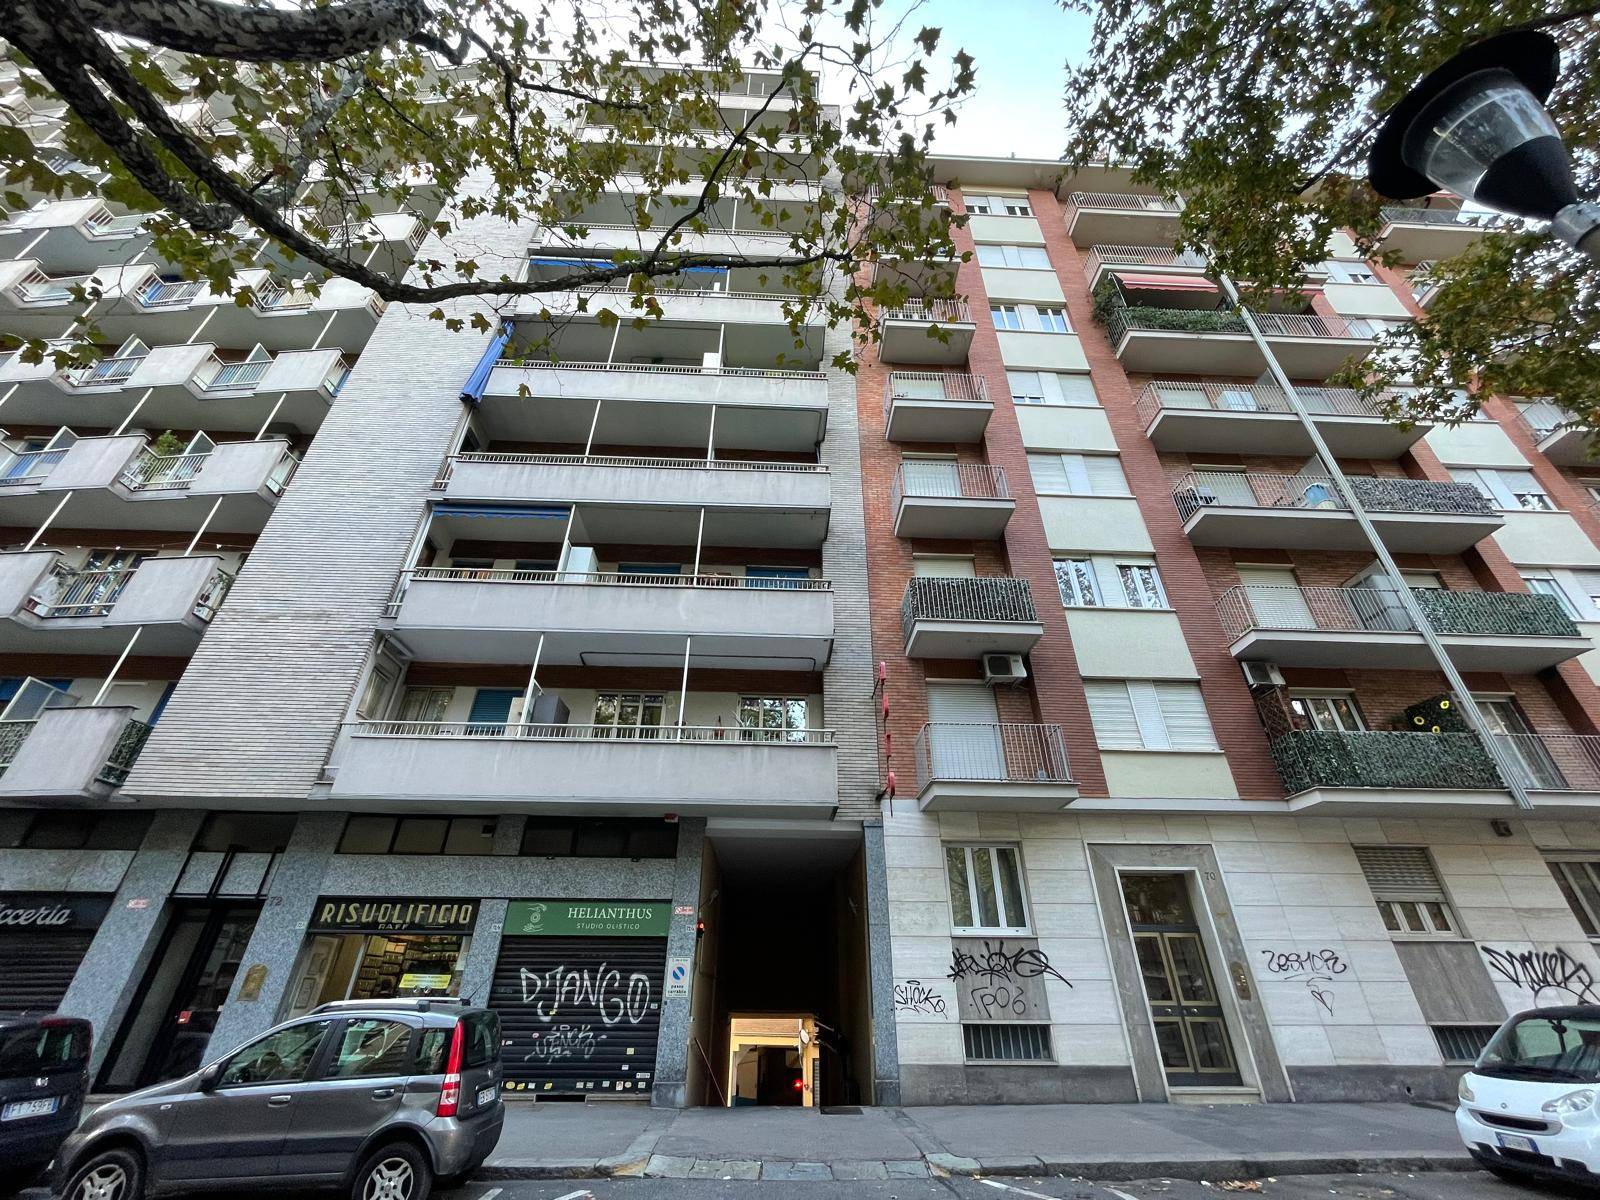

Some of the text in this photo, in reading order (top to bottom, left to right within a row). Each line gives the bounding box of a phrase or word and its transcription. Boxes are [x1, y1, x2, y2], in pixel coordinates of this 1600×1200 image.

[1203, 871, 1216, 881] 70
[270, 896, 282, 906] 72
[320, 903, 473, 924] RISUOLIFICIO
[567, 907, 652, 920] HELIANTHUS
[575, 922, 604, 930] STUDIO
[520, 962, 650, 1025] DJANGO
